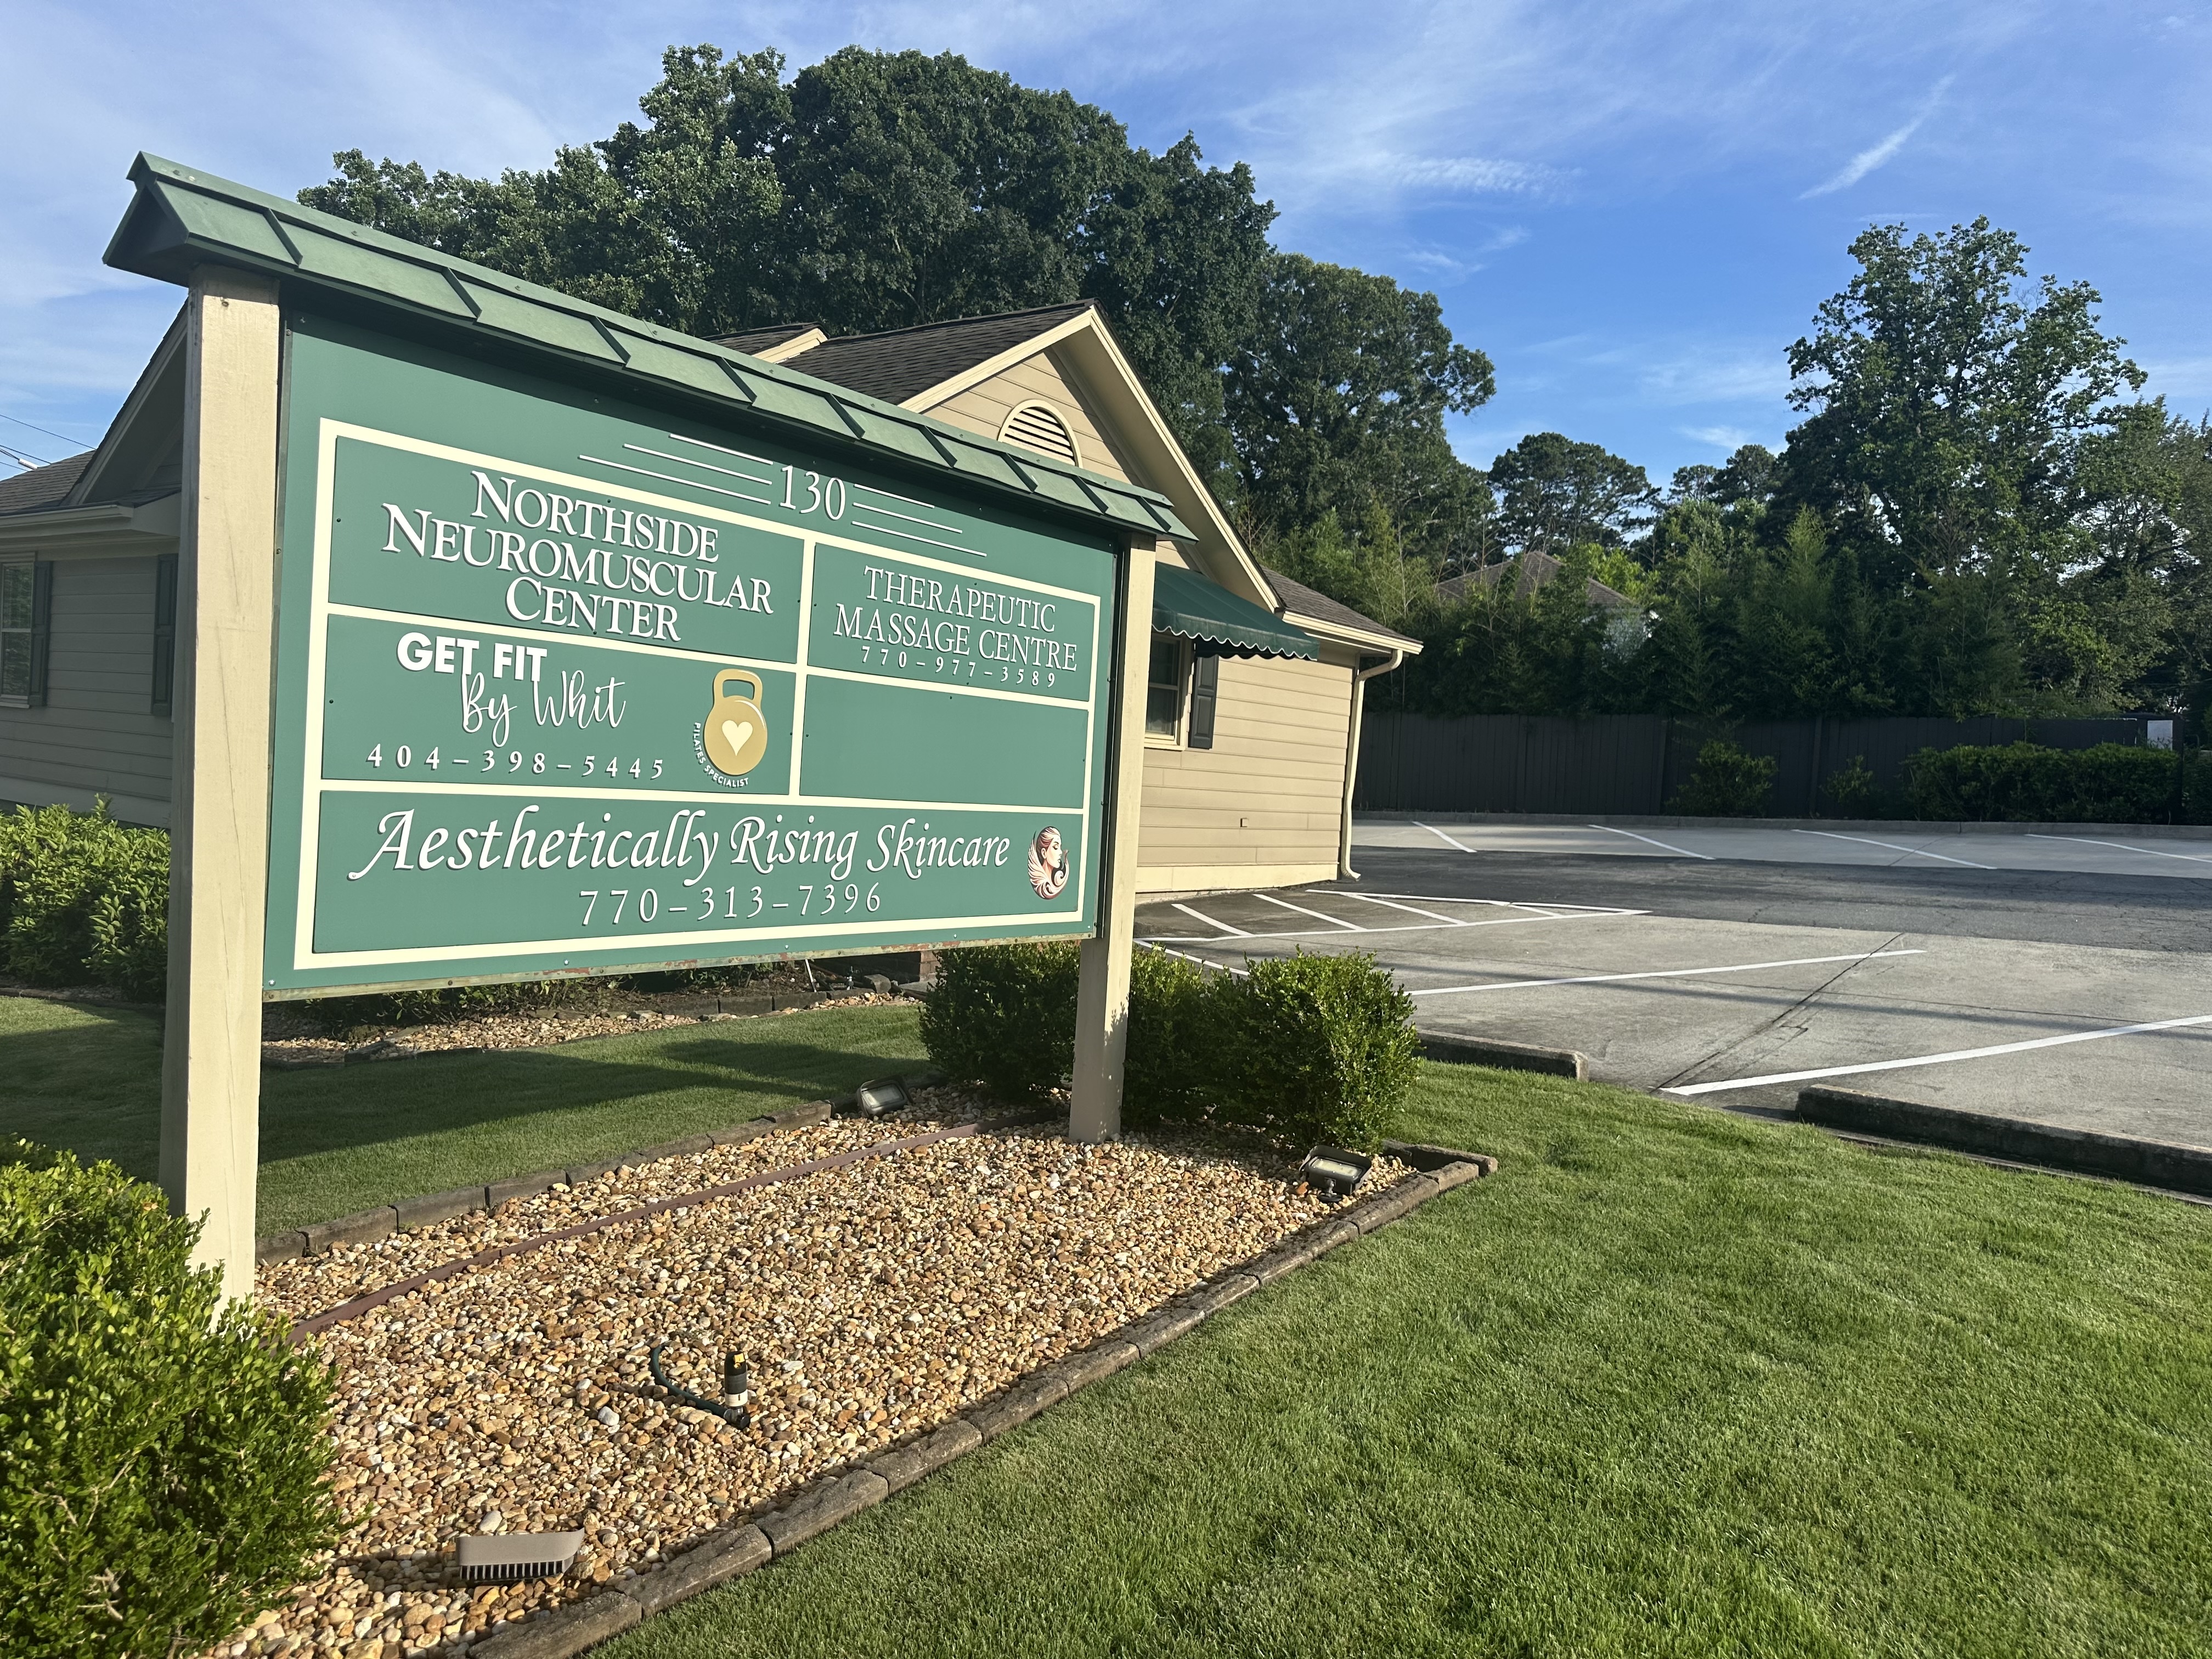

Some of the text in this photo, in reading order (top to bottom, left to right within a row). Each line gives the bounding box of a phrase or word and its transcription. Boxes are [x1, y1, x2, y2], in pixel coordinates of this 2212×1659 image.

[471, 470, 719, 563] NORTHSIDE
[779, 465, 847, 521] 130
[382, 502, 775, 614] NEUROMUSCULAR
[506, 575, 682, 642] CENTER
[864, 565, 1056, 633] THERAPEUTIC
[397, 631, 548, 682] GET FIT
[833, 602, 1077, 672] MASSAGE CENTRE
[861, 645, 1056, 689] 770-977-3589
[461, 669, 627, 748] By Whit
[366, 743, 664, 780] 404-398-5445
[693, 721, 749, 788] PILATES SPECIALIST
[348, 804, 1011, 887] Aesthetically Rising Skincare
[580, 881, 881, 926] 770-313-7396
